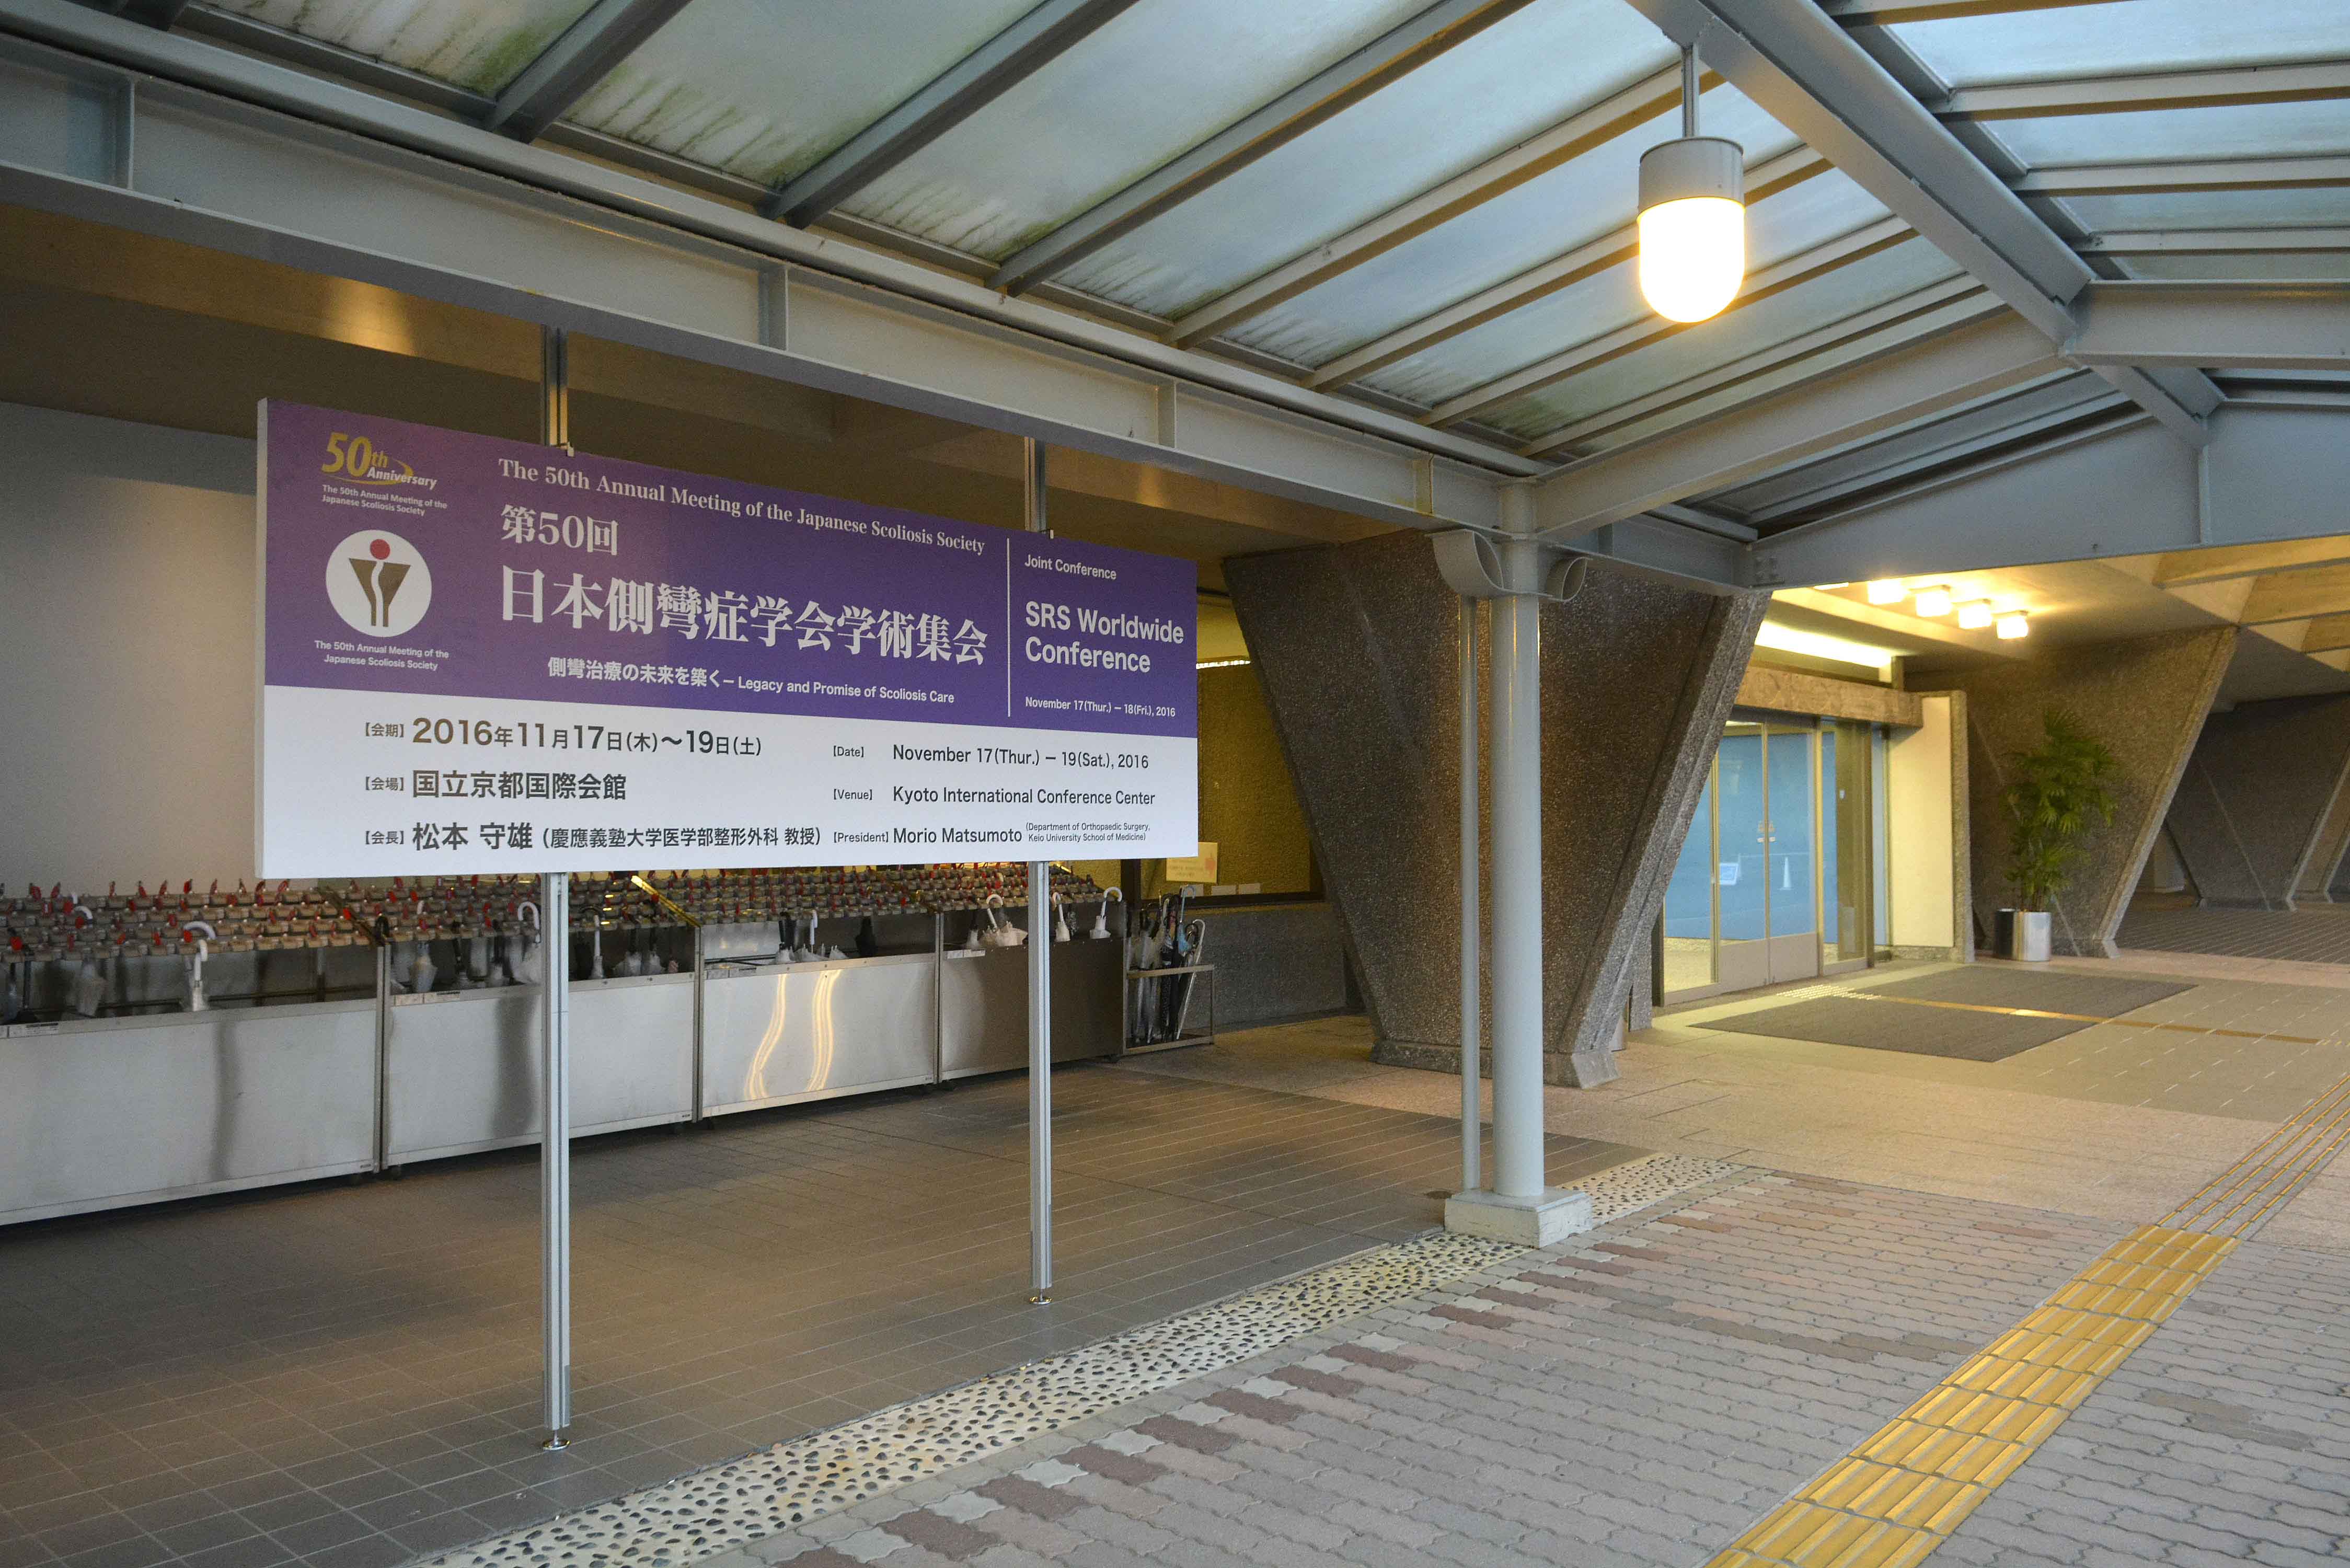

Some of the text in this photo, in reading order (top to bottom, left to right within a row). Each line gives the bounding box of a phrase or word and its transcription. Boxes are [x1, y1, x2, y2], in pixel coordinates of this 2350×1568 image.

[321, 432, 388, 477] 50th
[367, 466, 437, 489] Anniversary
[322, 485, 338, 493] The
[340, 487, 359, 497] 50th
[360, 489, 389, 501] Annual
[390, 494, 423, 507] Meeting
[434, 501, 447, 509] the
[322, 495, 425, 516] Japanese Scoliosis Society
[499, 458, 986, 556] The 50th Annual Meeting of the Japanese Scoliosis Society
[501, 504, 618, 556] 第50回
[1024, 554, 1116, 580] Joint Conference
[1026, 601, 1184, 644] SRS Worldwide
[315, 640, 331, 650] The
[334, 642, 354, 652] 50th
[357, 643, 387, 654] Annual
[389, 646, 422, 658] Meeting
[1026, 636, 1150, 673] Conference
[324, 654, 438, 671] Japanese Scoliosis Society
[738, 676, 783, 694] Legacy
[787, 681, 810, 694] and
[813, 682, 861, 697] Promise
[864, 686, 877, 698] of
[879, 687, 927, 701] Scoliosis
[930, 690, 954, 703] Care
[1025, 696, 1071, 710] November
[1074, 699, 1112, 713] 17(Thur.)
[1156, 707, 1176, 717] 2016
[893, 745, 971, 763] November
[977, 748, 1040, 766] 17(Thur.)
[1118, 755, 1149, 769] 2016
[413, 770, 627, 800] 国立京都国際会館
[893, 786, 939, 804] Kyoto
[943, 787, 1033, 804] International
[1037, 789, 1112, 804] Conference
[1115, 791, 1155, 805] Center
[412, 822, 468, 851] 松本
[480, 822, 533, 850] 守雄
[893, 828, 937, 844] Morio
[942, 828, 1022, 843] Matsumoto
[1026, 823, 1070, 832] (Department
[1081, 823, 1122, 831] Orthopaedic
[1124, 823, 1150, 832] Surgery,
[1046, 834, 1081, 843] University
